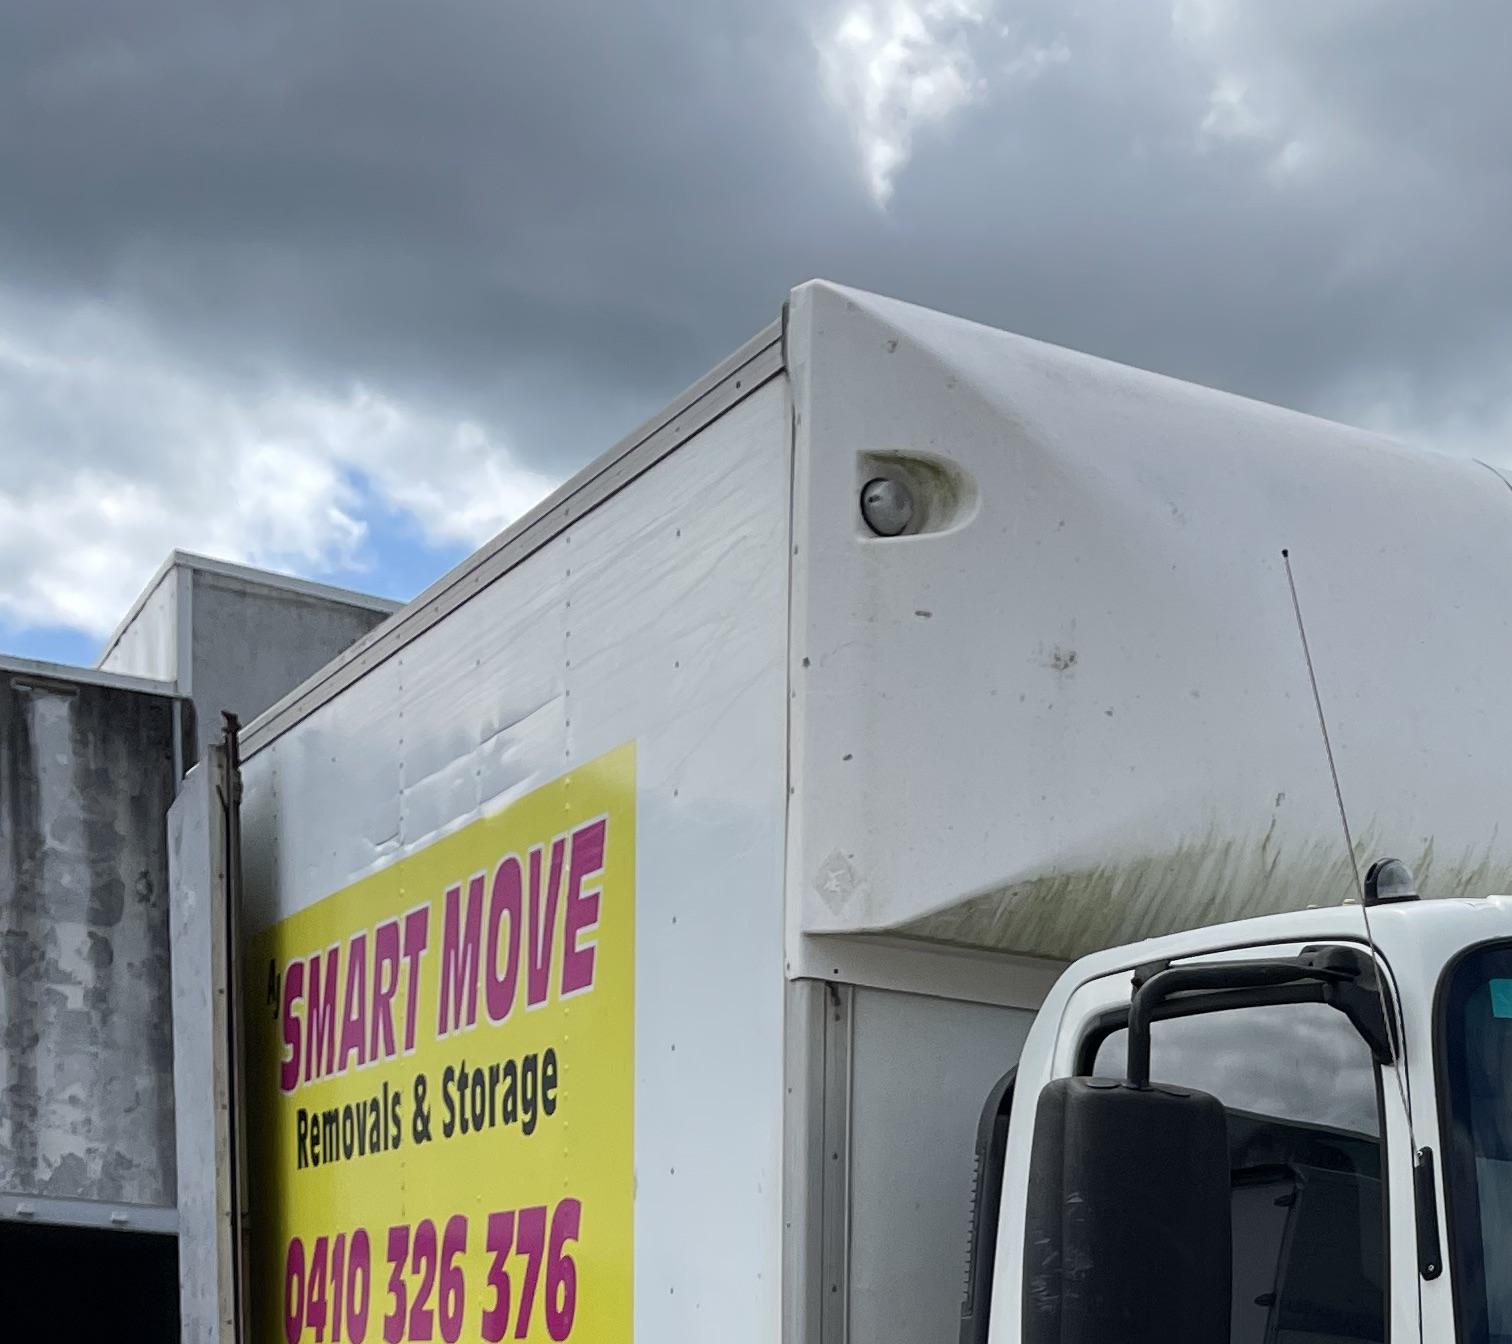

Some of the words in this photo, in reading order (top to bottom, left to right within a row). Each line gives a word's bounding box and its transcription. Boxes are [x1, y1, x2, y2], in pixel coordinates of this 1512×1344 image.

[279, 903, 431, 1094] SMART
[437, 815, 608, 1038] MOVE
[296, 1081, 402, 1170] Removals
[411, 1073, 433, 1145] &
[441, 1047, 559, 1137] Storage
[480, 1196, 583, 1344] 376
